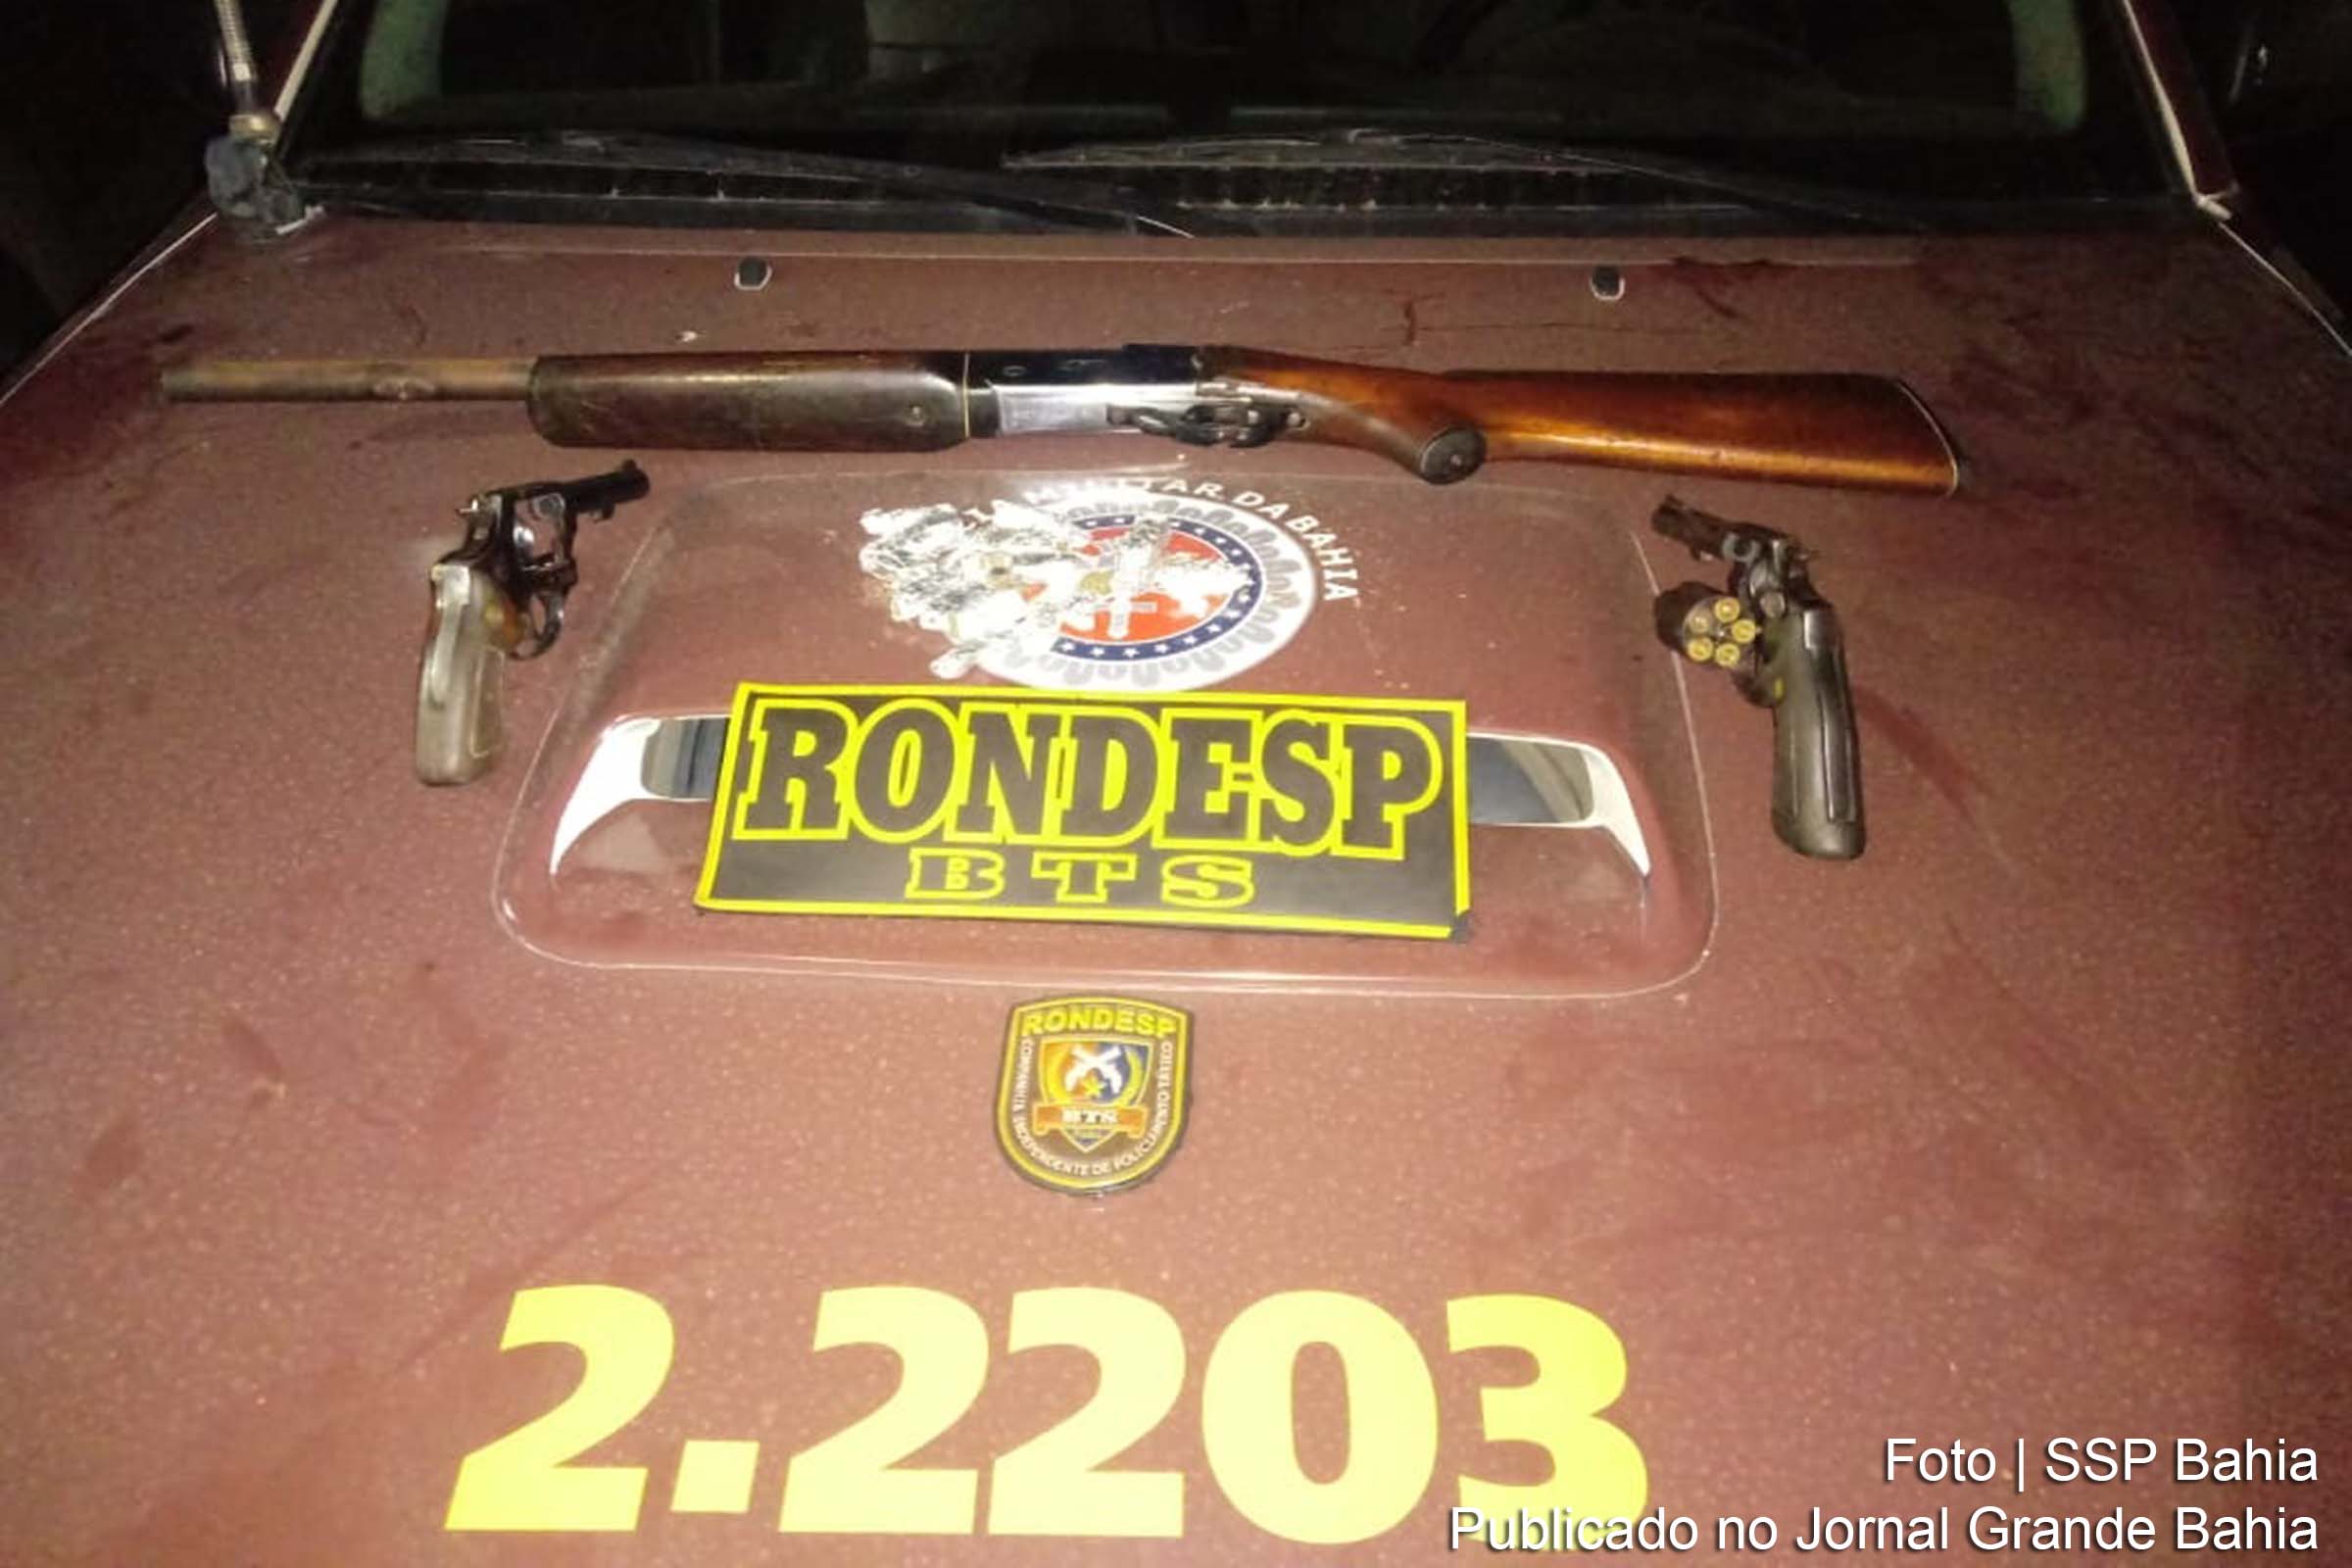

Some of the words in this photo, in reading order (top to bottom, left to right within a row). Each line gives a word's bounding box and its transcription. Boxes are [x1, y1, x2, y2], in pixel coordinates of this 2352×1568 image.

[1022, 474, 1223, 506] MITAR
[1231, 491, 1291, 519] DA
[1284, 514, 1359, 601] BAHIA
[733, 697, 1444, 860] RONDESP
[906, 848, 1255, 907] BTS
[1021, 1004, 1176, 1039] RONDESP
[1092, 1161, 1112, 1176] DE
[443, 1282, 1650, 1548] 2.2203
